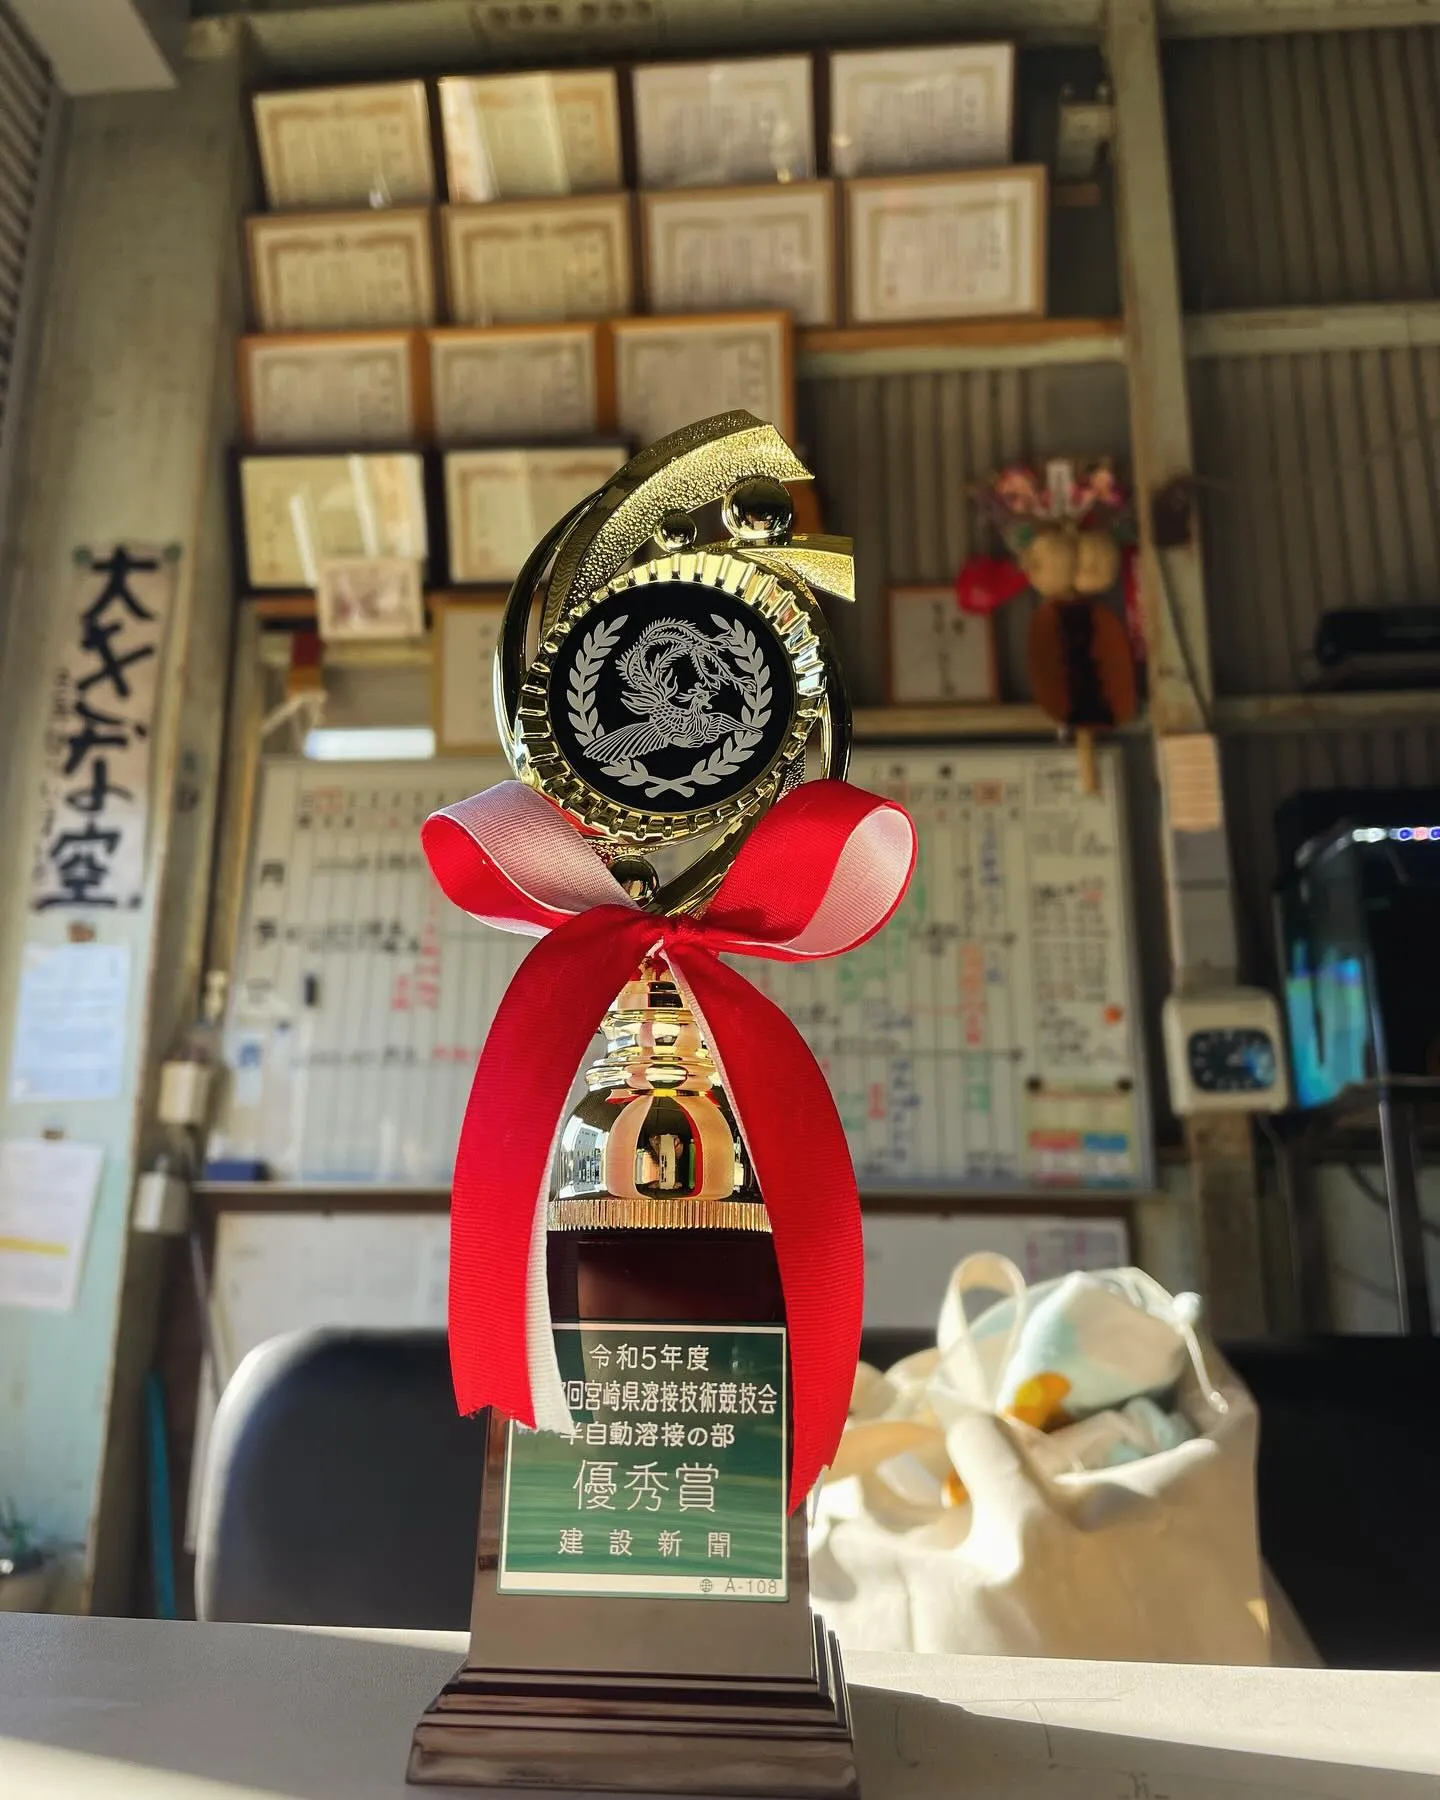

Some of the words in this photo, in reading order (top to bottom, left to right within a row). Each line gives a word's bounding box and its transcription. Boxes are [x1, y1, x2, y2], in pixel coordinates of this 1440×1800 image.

[589, 1343, 710, 1372] 令和5年度
[561, 1380, 778, 1415] 回宮崎県溶接技術競技会
[573, 1459, 720, 1513] 優秀賞
[558, 1528, 731, 1558] 建設新聞
[725, 1577, 777, 1594] A-108
